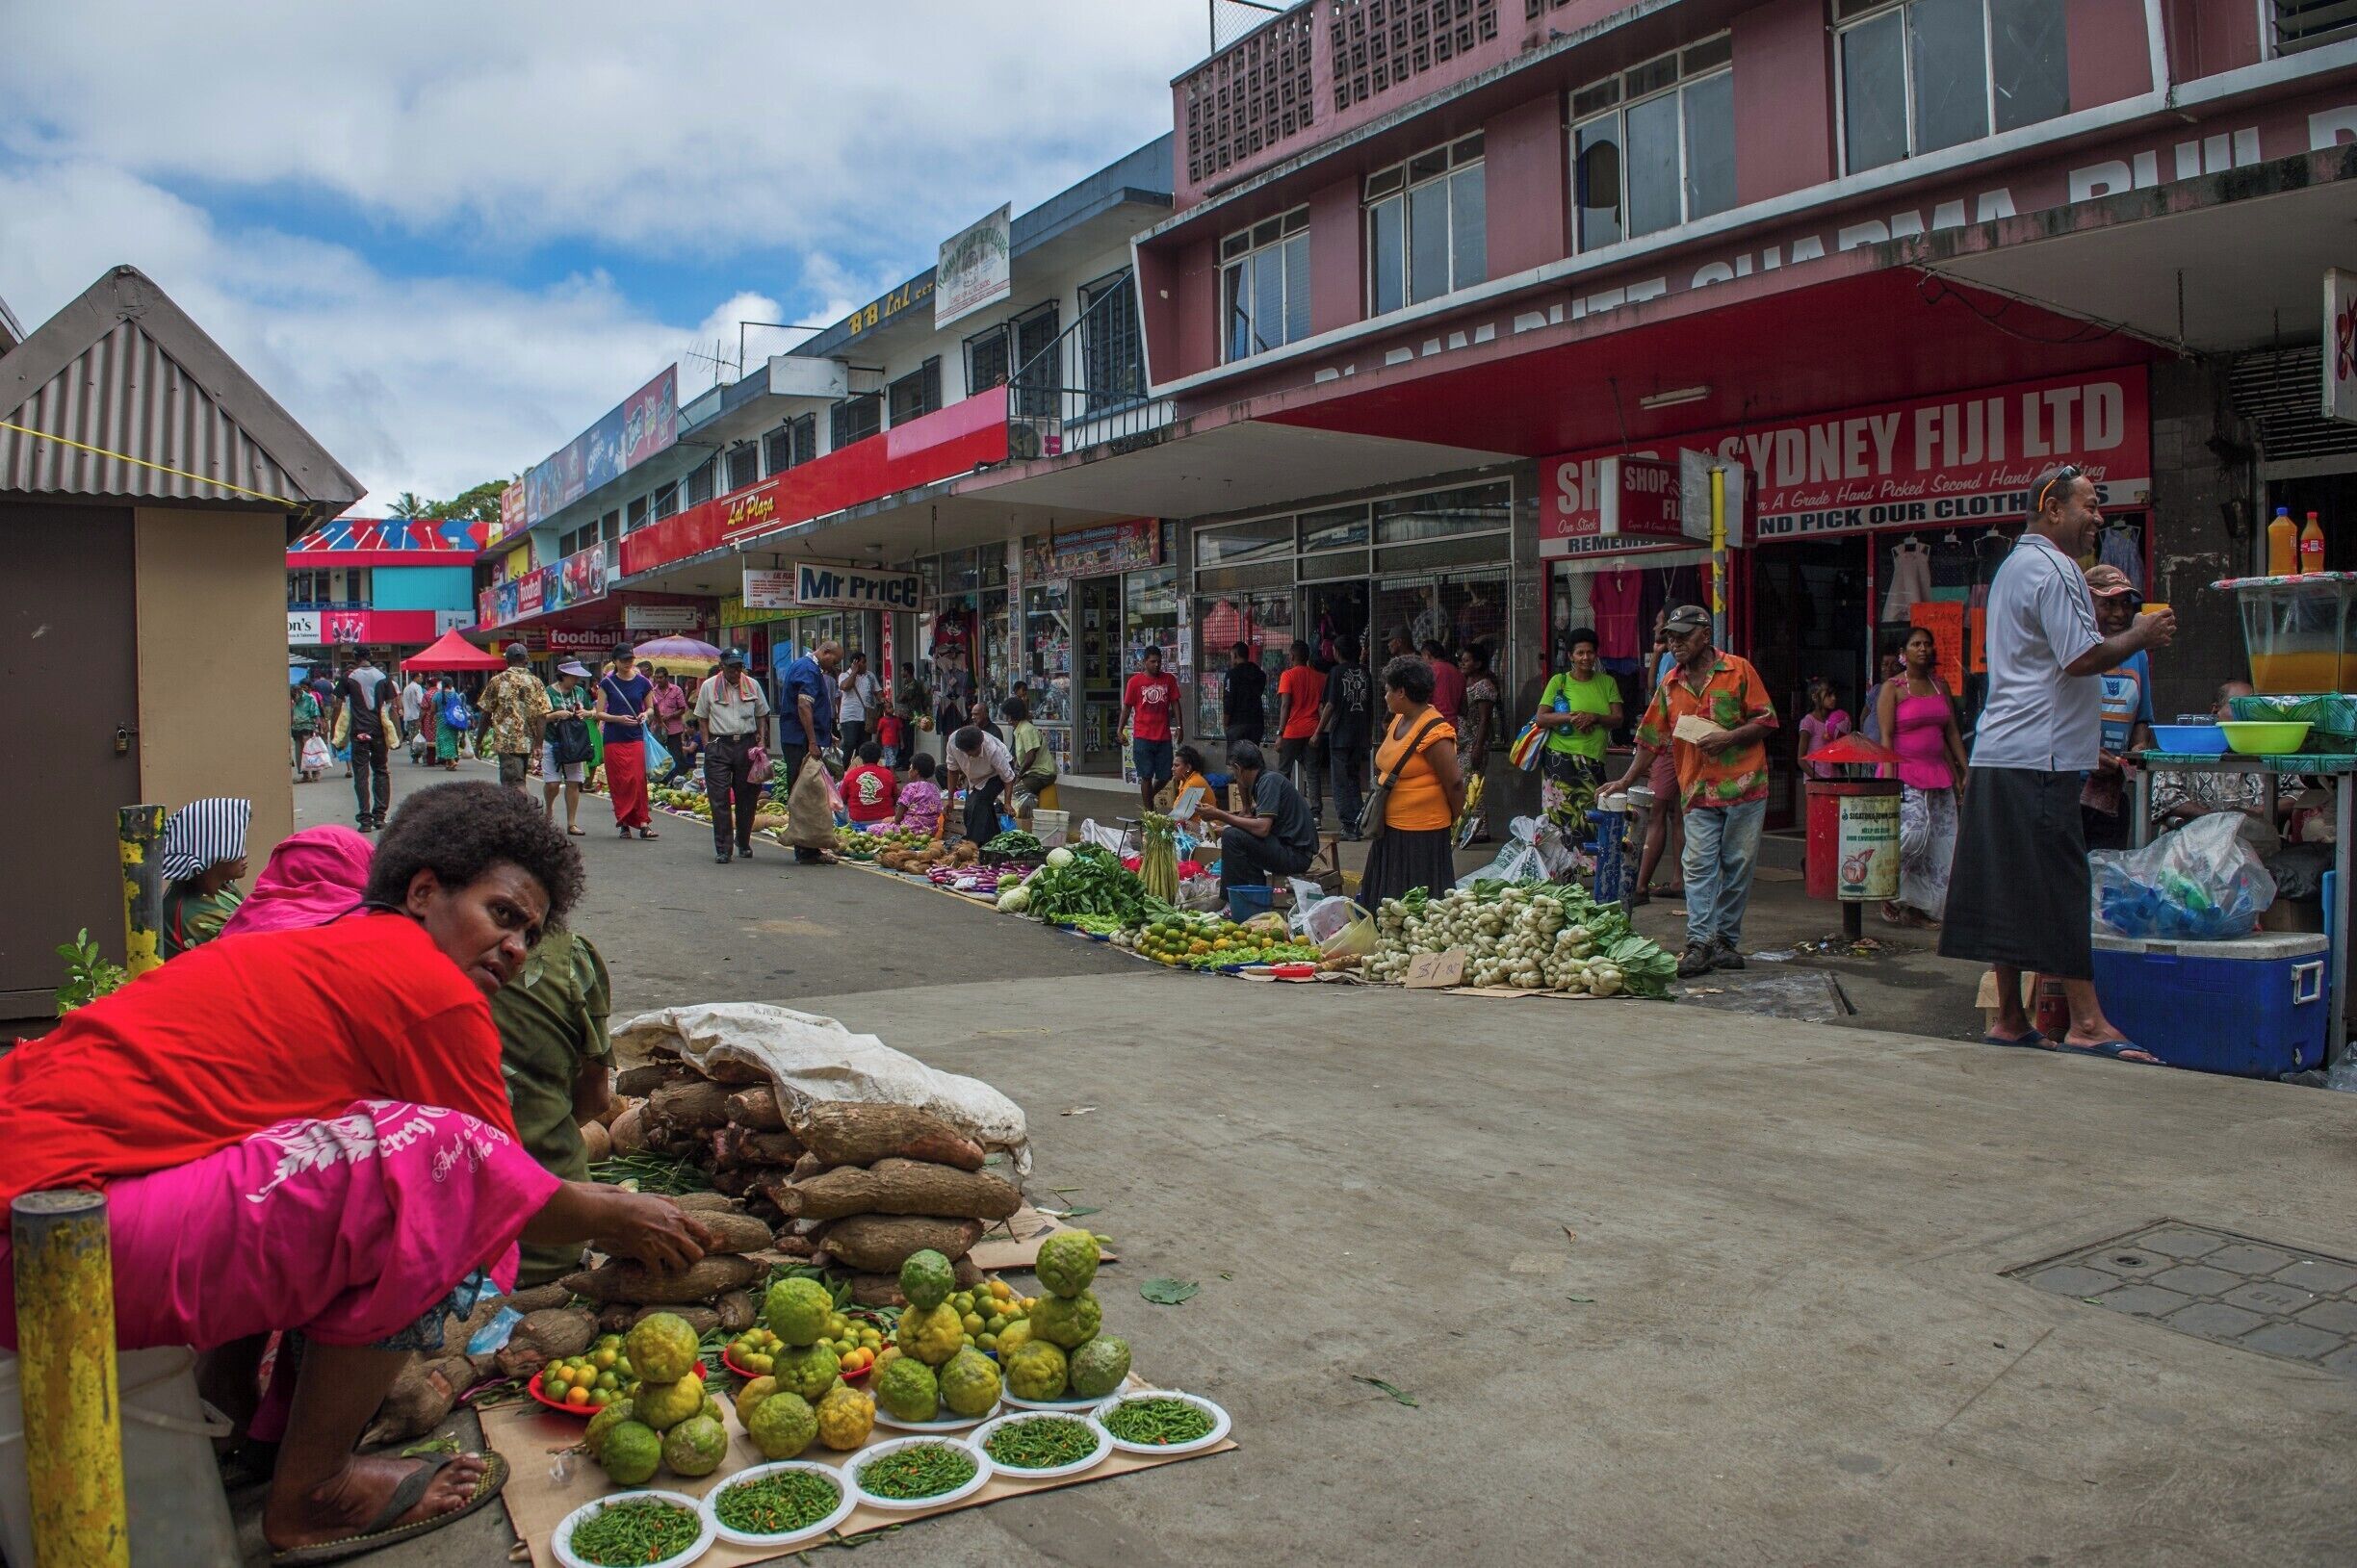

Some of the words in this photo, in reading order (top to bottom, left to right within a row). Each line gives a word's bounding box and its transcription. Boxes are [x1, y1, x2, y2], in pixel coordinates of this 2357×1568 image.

[1915, 396, 2006, 471] FIJI
[2023, 382, 2124, 458] LTD
[1624, 466, 1670, 494] SHOP
[1772, 492, 1785, 510] A
[1791, 490, 1830, 508] Grade
[1835, 482, 1875, 503] Hand
[1880, 477, 1926, 499] Picked
[1930, 473, 1983, 493] Second
[1988, 465, 2034, 486] Hand
[746, 494, 774, 522] Plaza
[1759, 515, 1794, 535] ND
[1800, 508, 1863, 531] PICK
[1869, 501, 1927, 525] OUR
[1934, 484, 2110, 519] CLOTHS
[1558, 519, 1574, 534] Our
[1576, 517, 1597, 532] Stock
[801, 567, 845, 601] Mr
[849, 576, 919, 608] Price
[551, 630, 622, 645] foodhall
